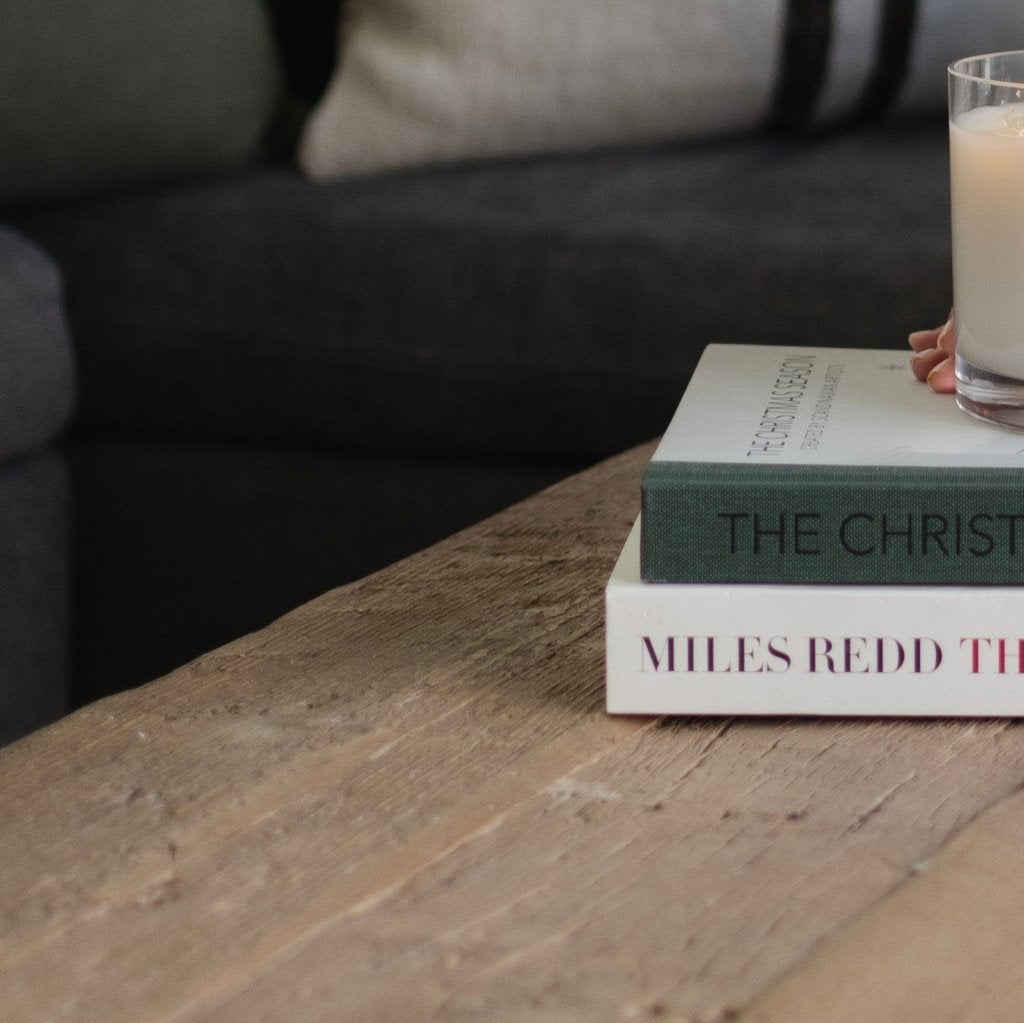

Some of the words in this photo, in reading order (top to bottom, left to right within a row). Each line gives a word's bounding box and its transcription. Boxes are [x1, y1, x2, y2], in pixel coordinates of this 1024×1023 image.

[717, 512, 822, 556] THE
[637, 635, 792, 674] MILES
[804, 636, 944, 675] REDD
